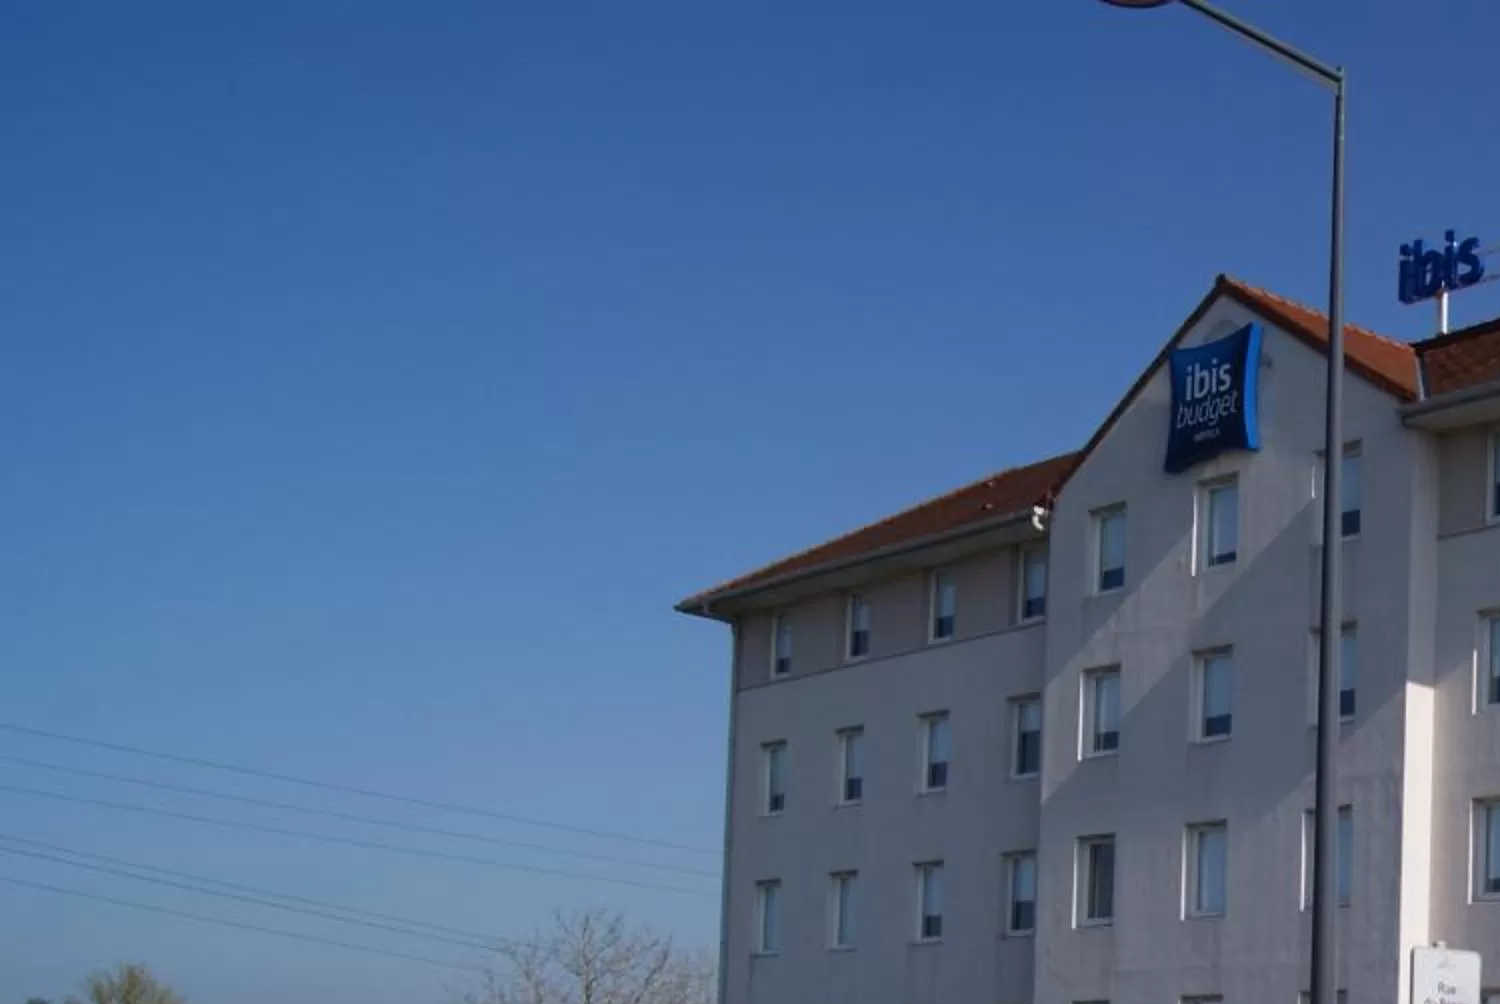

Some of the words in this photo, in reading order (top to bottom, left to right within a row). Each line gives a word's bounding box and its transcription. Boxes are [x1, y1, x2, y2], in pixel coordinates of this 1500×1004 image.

[1398, 229, 1485, 304] ibis
[1185, 357, 1232, 401] ibis
[1177, 390, 1239, 429] budget
